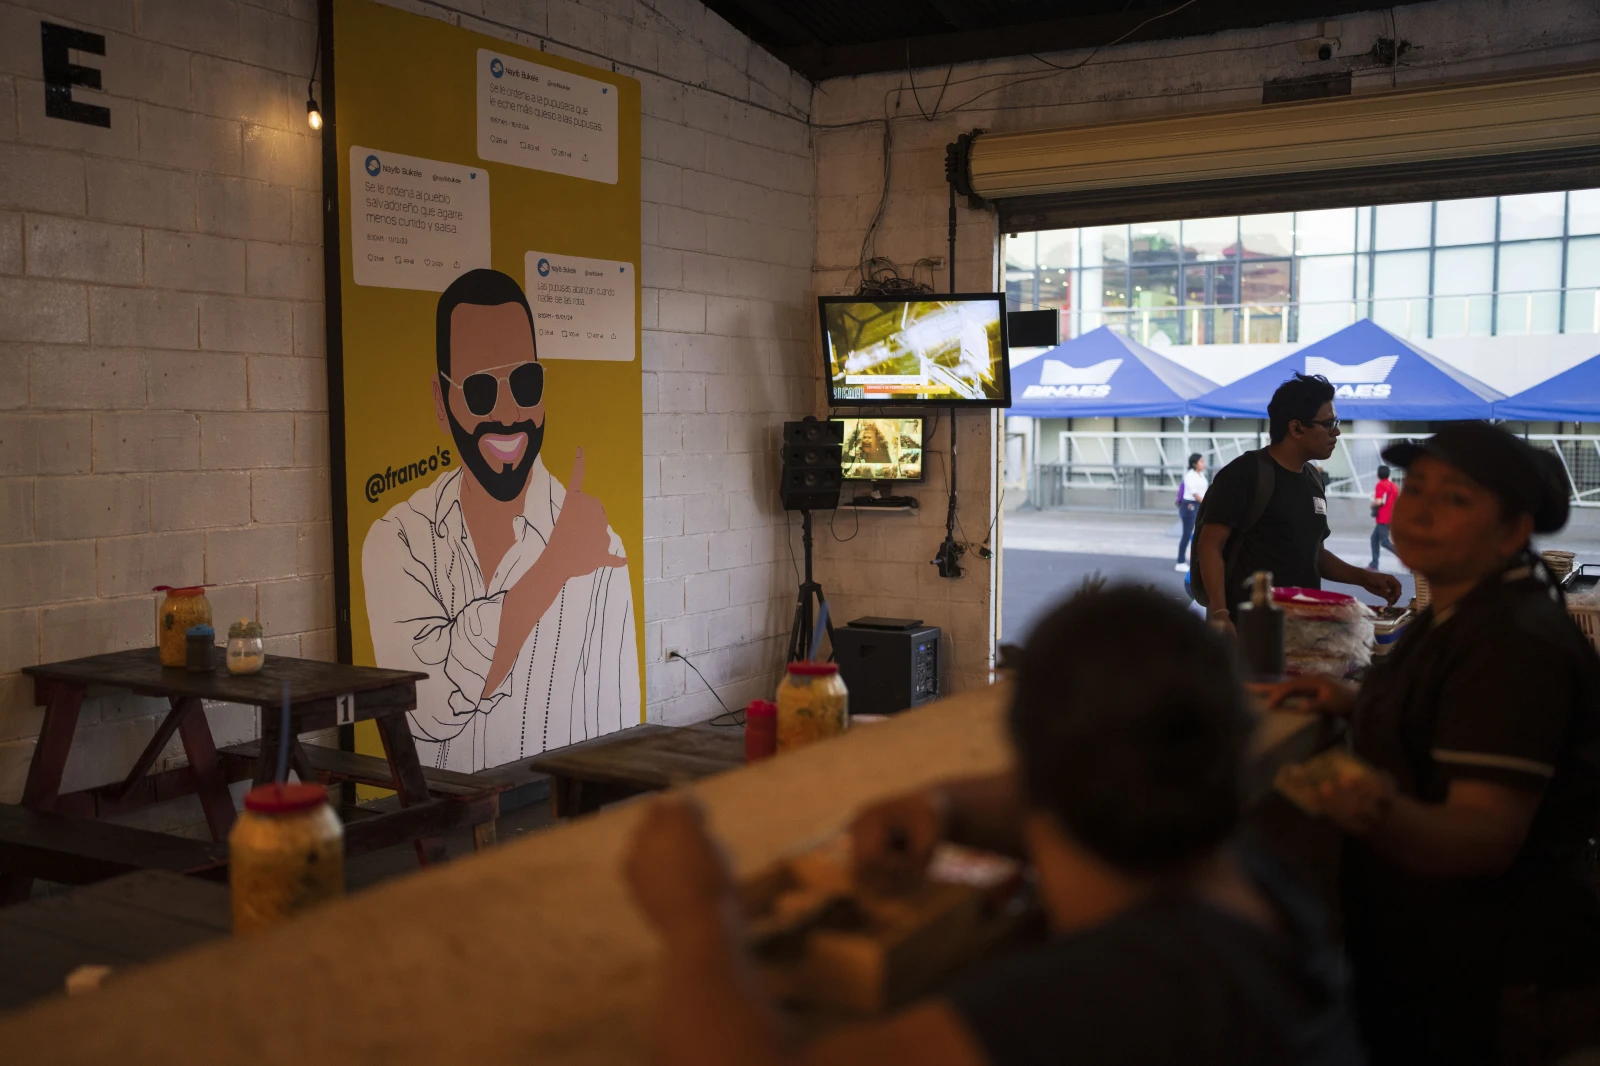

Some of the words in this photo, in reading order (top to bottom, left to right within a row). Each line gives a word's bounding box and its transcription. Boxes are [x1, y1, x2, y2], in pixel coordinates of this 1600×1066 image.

[41, 21, 111, 129] E
[506, 67, 520, 78] Nayib
[522, 71, 539, 82] Bukele
[490, 82, 498, 94] Se
[500, 85, 506, 95] le
[506, 87, 530, 101] ordena
[531, 94, 536, 102] a
[537, 95, 543, 104] la
[544, 97, 575, 112] pupusera
[576, 104, 588, 116] que
[490, 96, 496, 106] le
[497, 98, 516, 112] eche
[517, 103, 533, 115] más
[534, 108, 556, 120] queso
[562, 114, 573, 124] las
[574, 117, 603, 132] pupusas.
[383, 165, 400, 174] Nayib
[402, 167, 422, 178] Bukele
[365, 182, 375, 192] Se
[377, 183, 384, 194] le
[387, 184, 414, 199] ordena
[416, 190, 422, 200] al
[424, 192, 450, 204] pueblo
[366, 197, 418, 214] salvadoreño
[421, 206, 435, 218] que
[438, 208, 464, 221] agarre
[367, 213, 397, 226] menos
[398, 216, 425, 229] curtido
[428, 222, 432, 232] y
[435, 222, 458, 234] salsa.
[538, 282, 547, 290] Las
[549, 283, 571, 293] pupusas
[597, 287, 615, 296] cuando
[538, 294, 553, 303] nadie
[1022, 384, 1112, 399] BINAES
[365, 445, 451, 504] @franco's
[341, 696, 350, 722] 1
